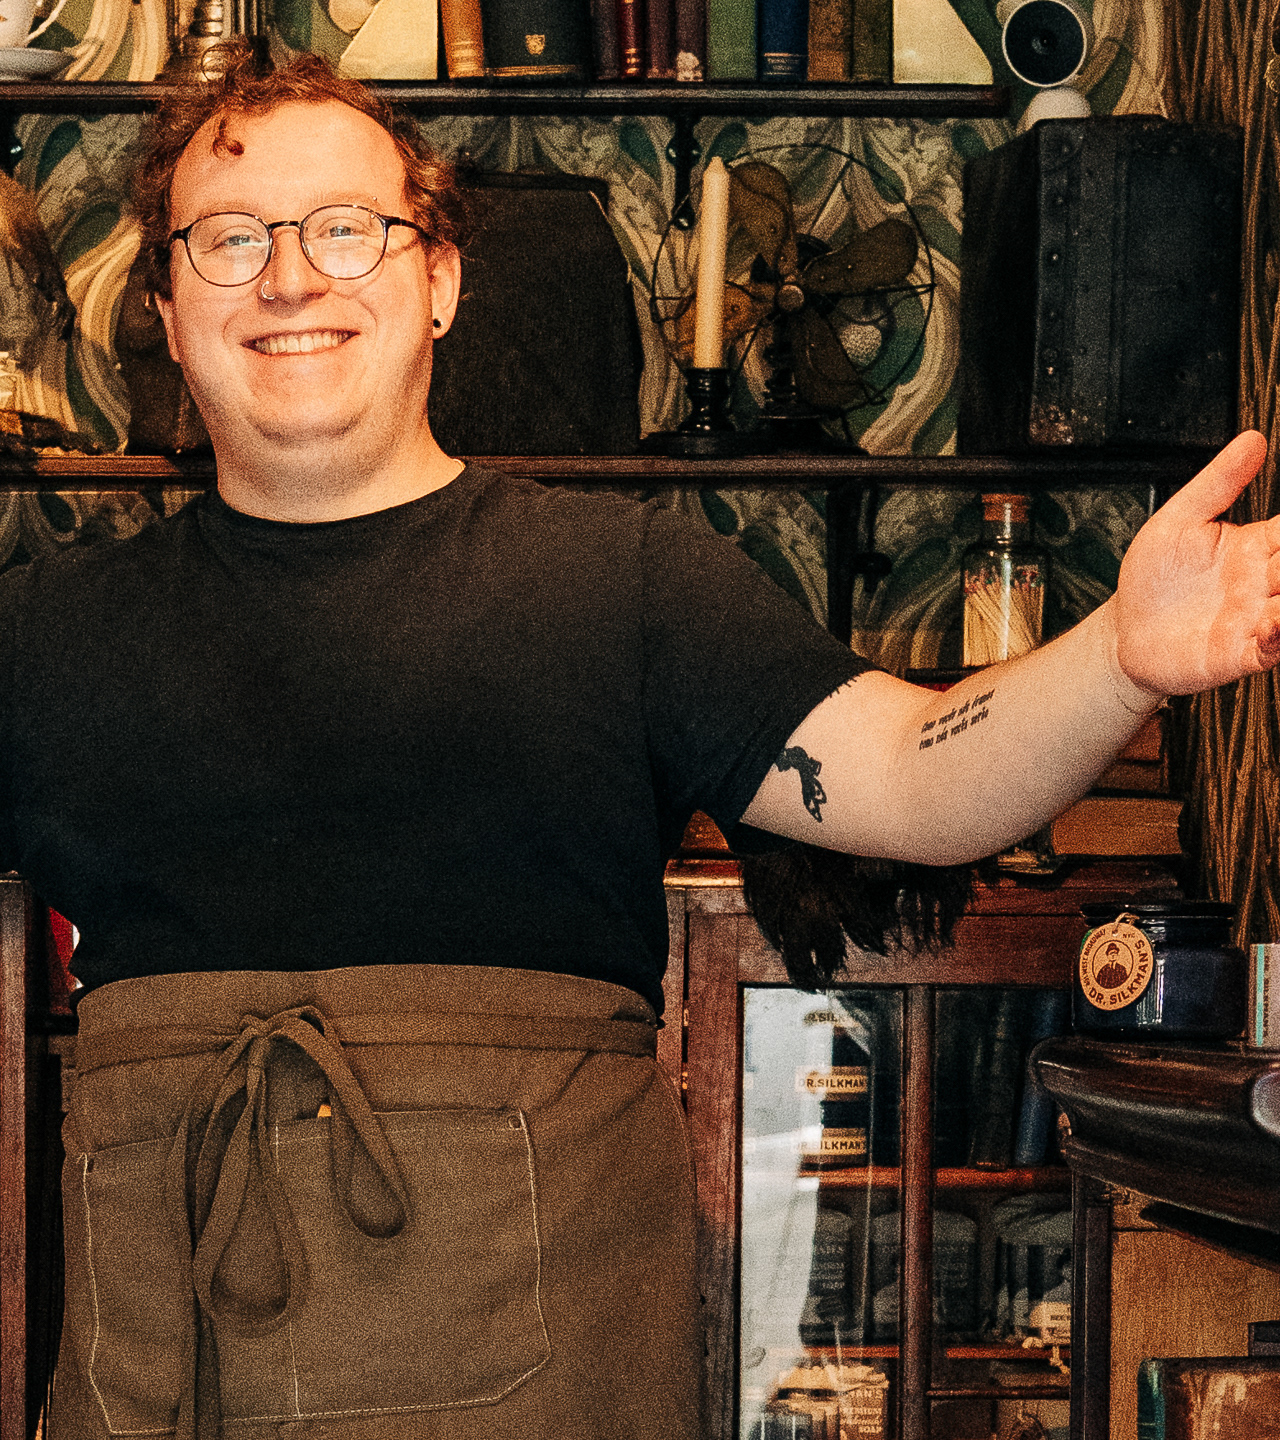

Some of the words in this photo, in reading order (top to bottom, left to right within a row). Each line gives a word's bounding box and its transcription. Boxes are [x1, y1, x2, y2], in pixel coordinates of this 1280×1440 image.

[1122, 932, 1136, 940] NYC
[1088, 987, 1107, 1006] DR.
[1109, 938, 1150, 1006] SILKMAN'S
